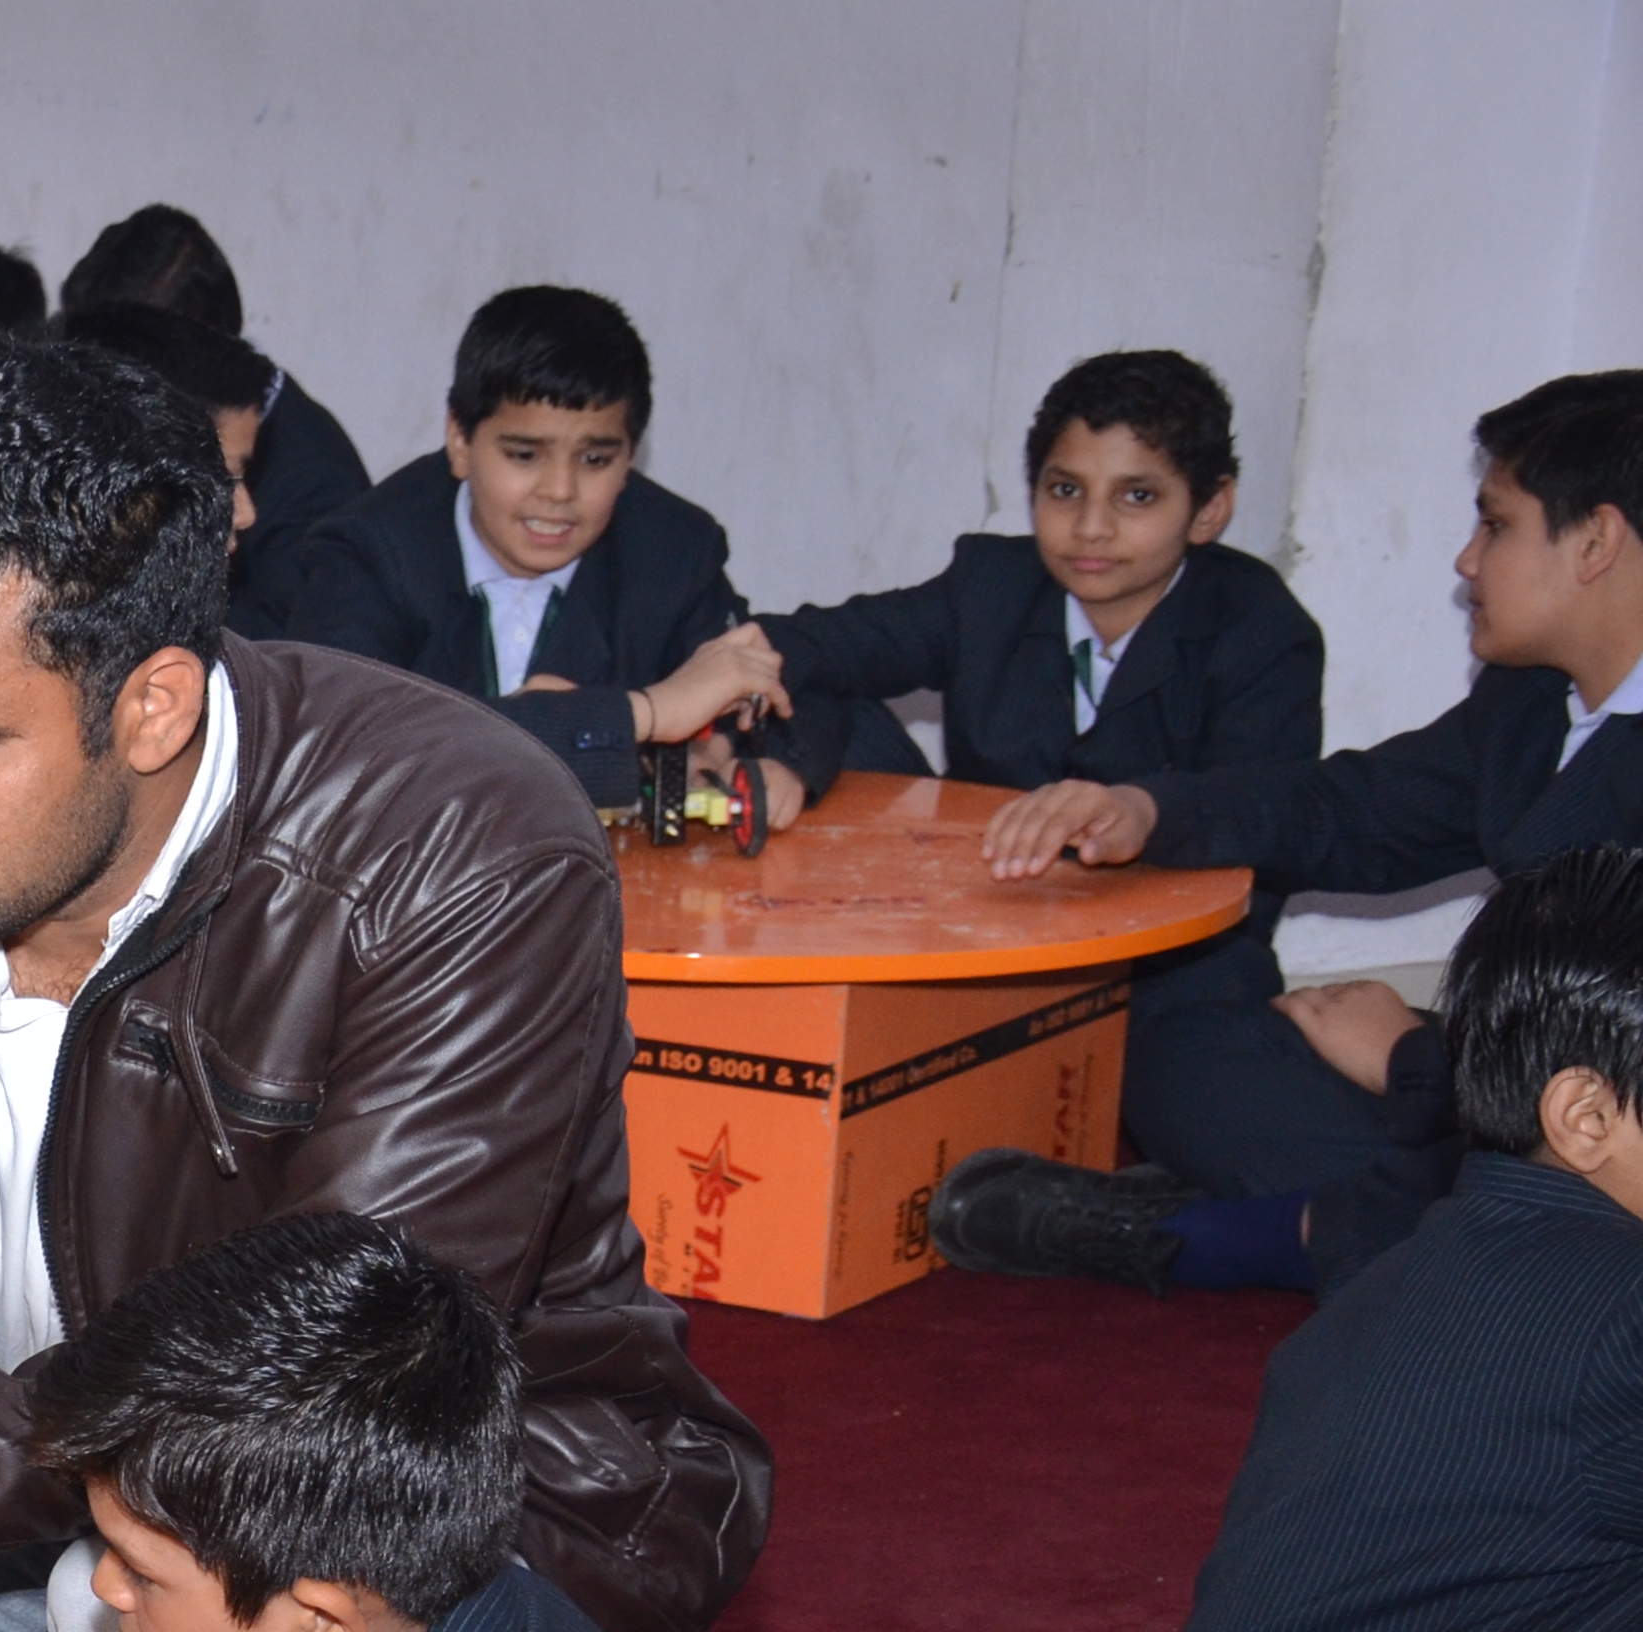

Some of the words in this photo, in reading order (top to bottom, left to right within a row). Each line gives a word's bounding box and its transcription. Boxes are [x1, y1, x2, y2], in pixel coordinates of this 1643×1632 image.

[659, 1050, 703, 1074] ISO
[708, 1056, 766, 1083] 9001
[773, 1066, 795, 1088] &
